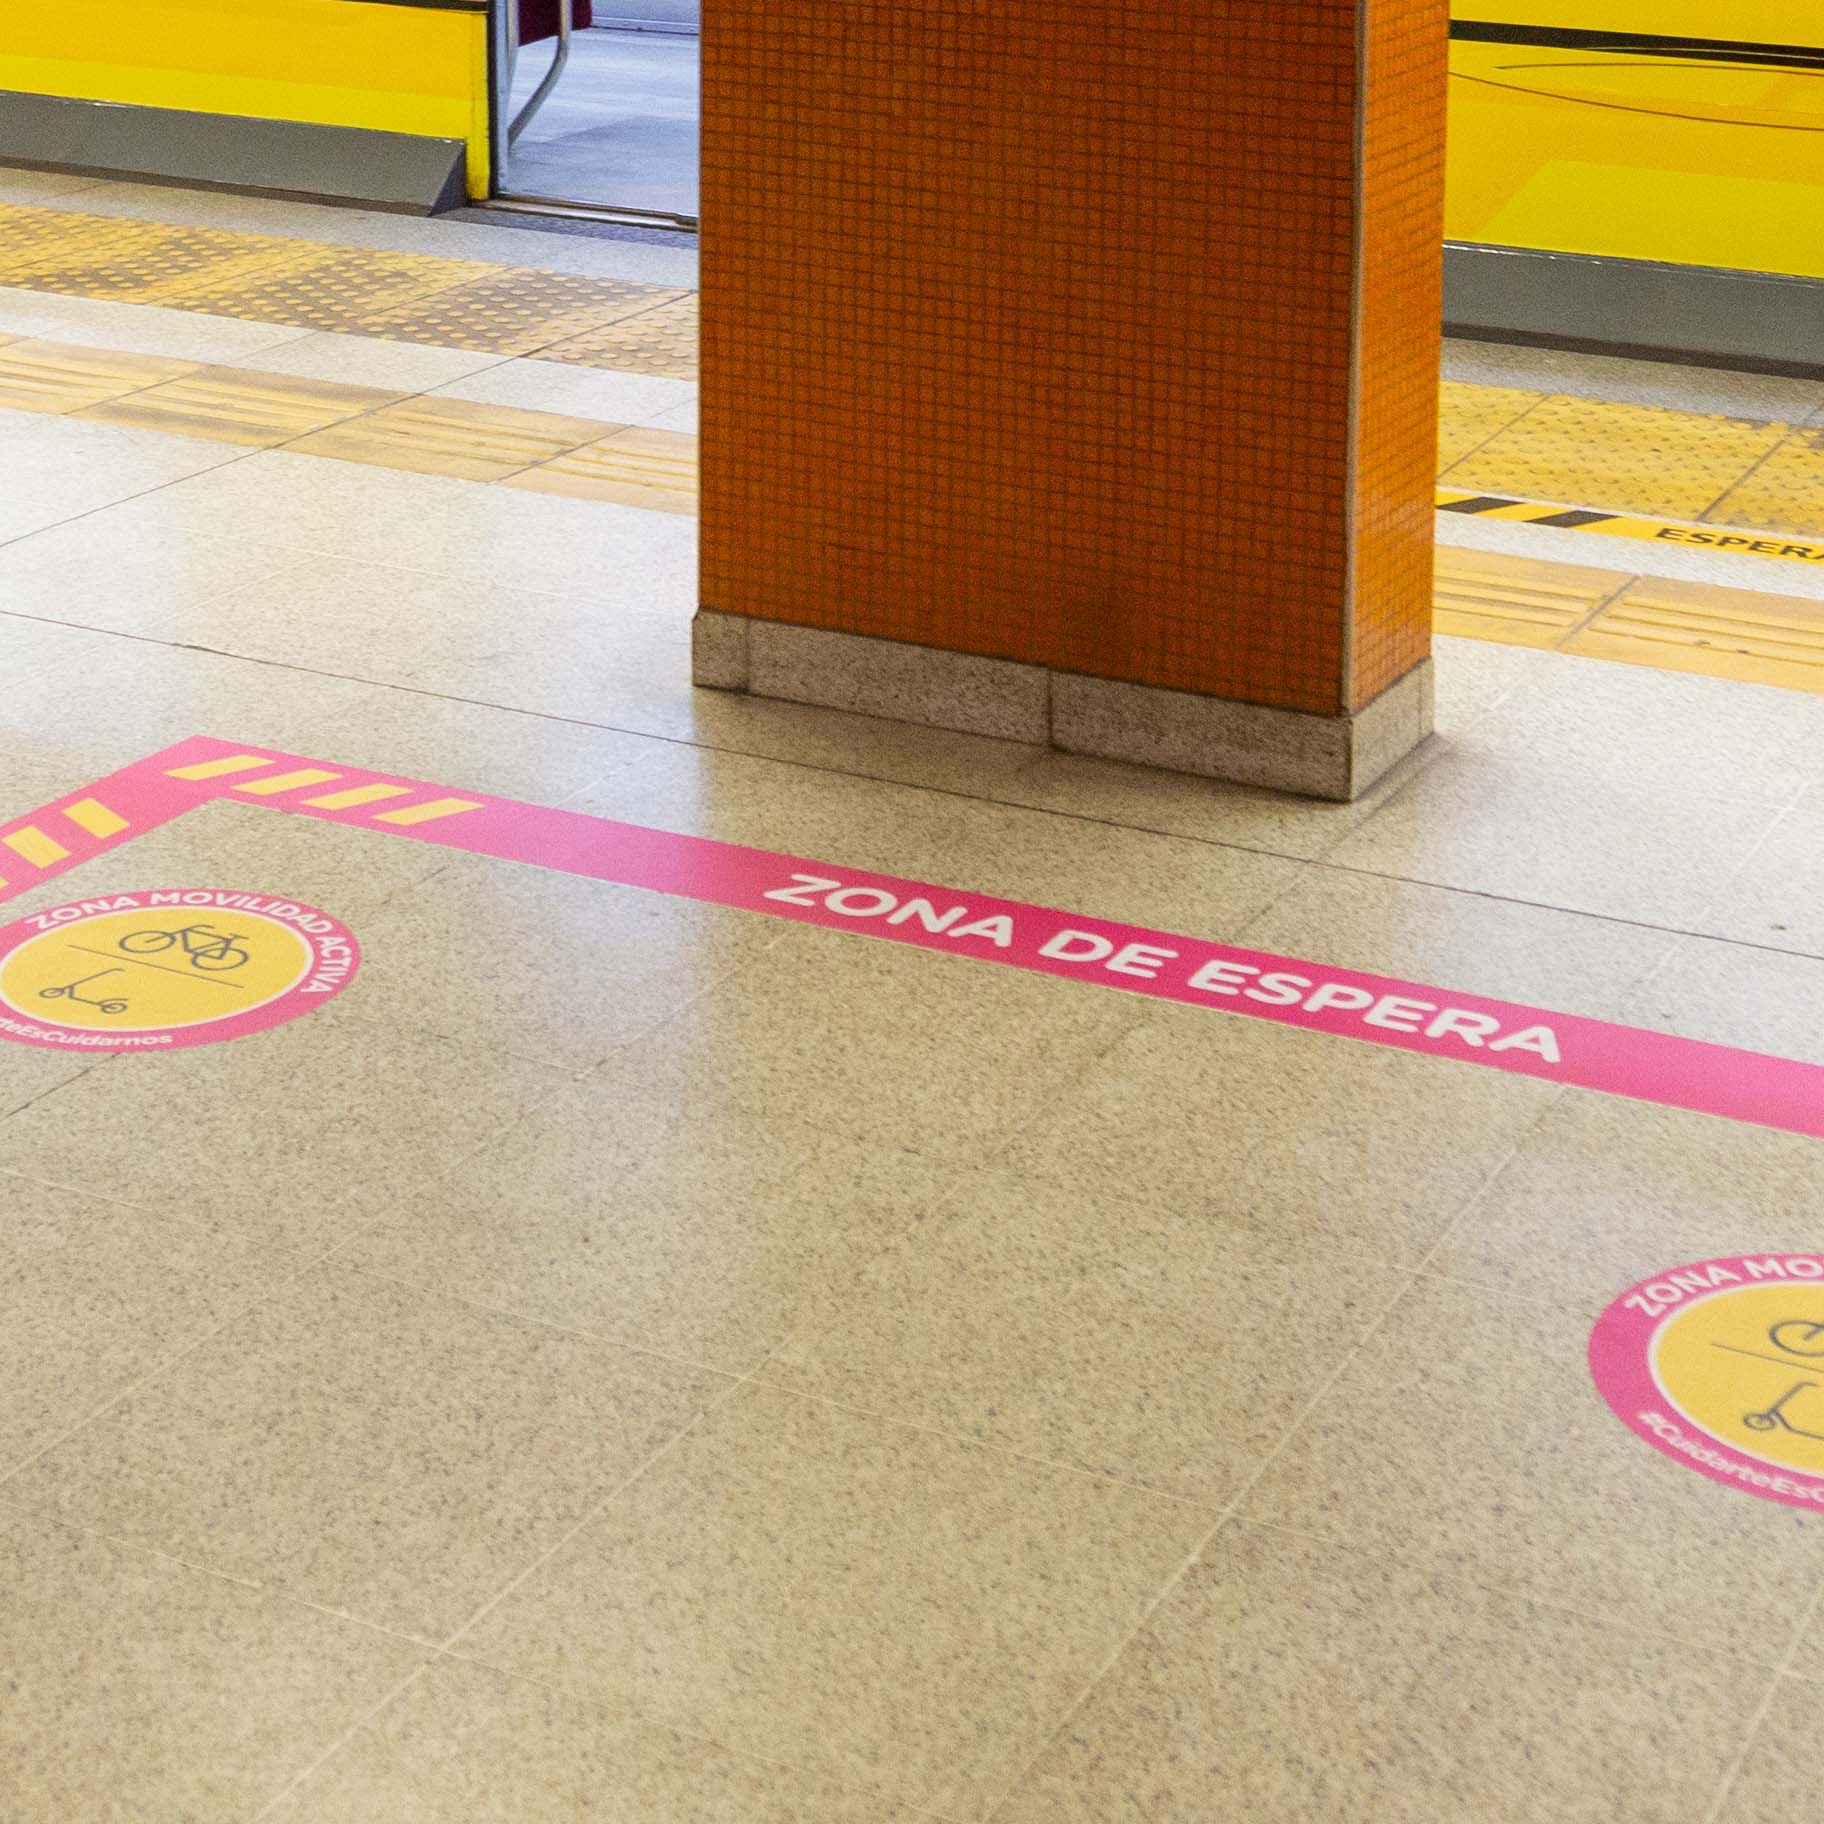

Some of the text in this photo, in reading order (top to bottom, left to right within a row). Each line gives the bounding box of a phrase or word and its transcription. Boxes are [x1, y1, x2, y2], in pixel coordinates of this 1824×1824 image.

[25, 890, 353, 994] ZONA MOVILIDAD ACTIVA
[764, 873, 1564, 1064] ZONA DE ESPERA
[1623, 1265, 1742, 1319] ZONA
